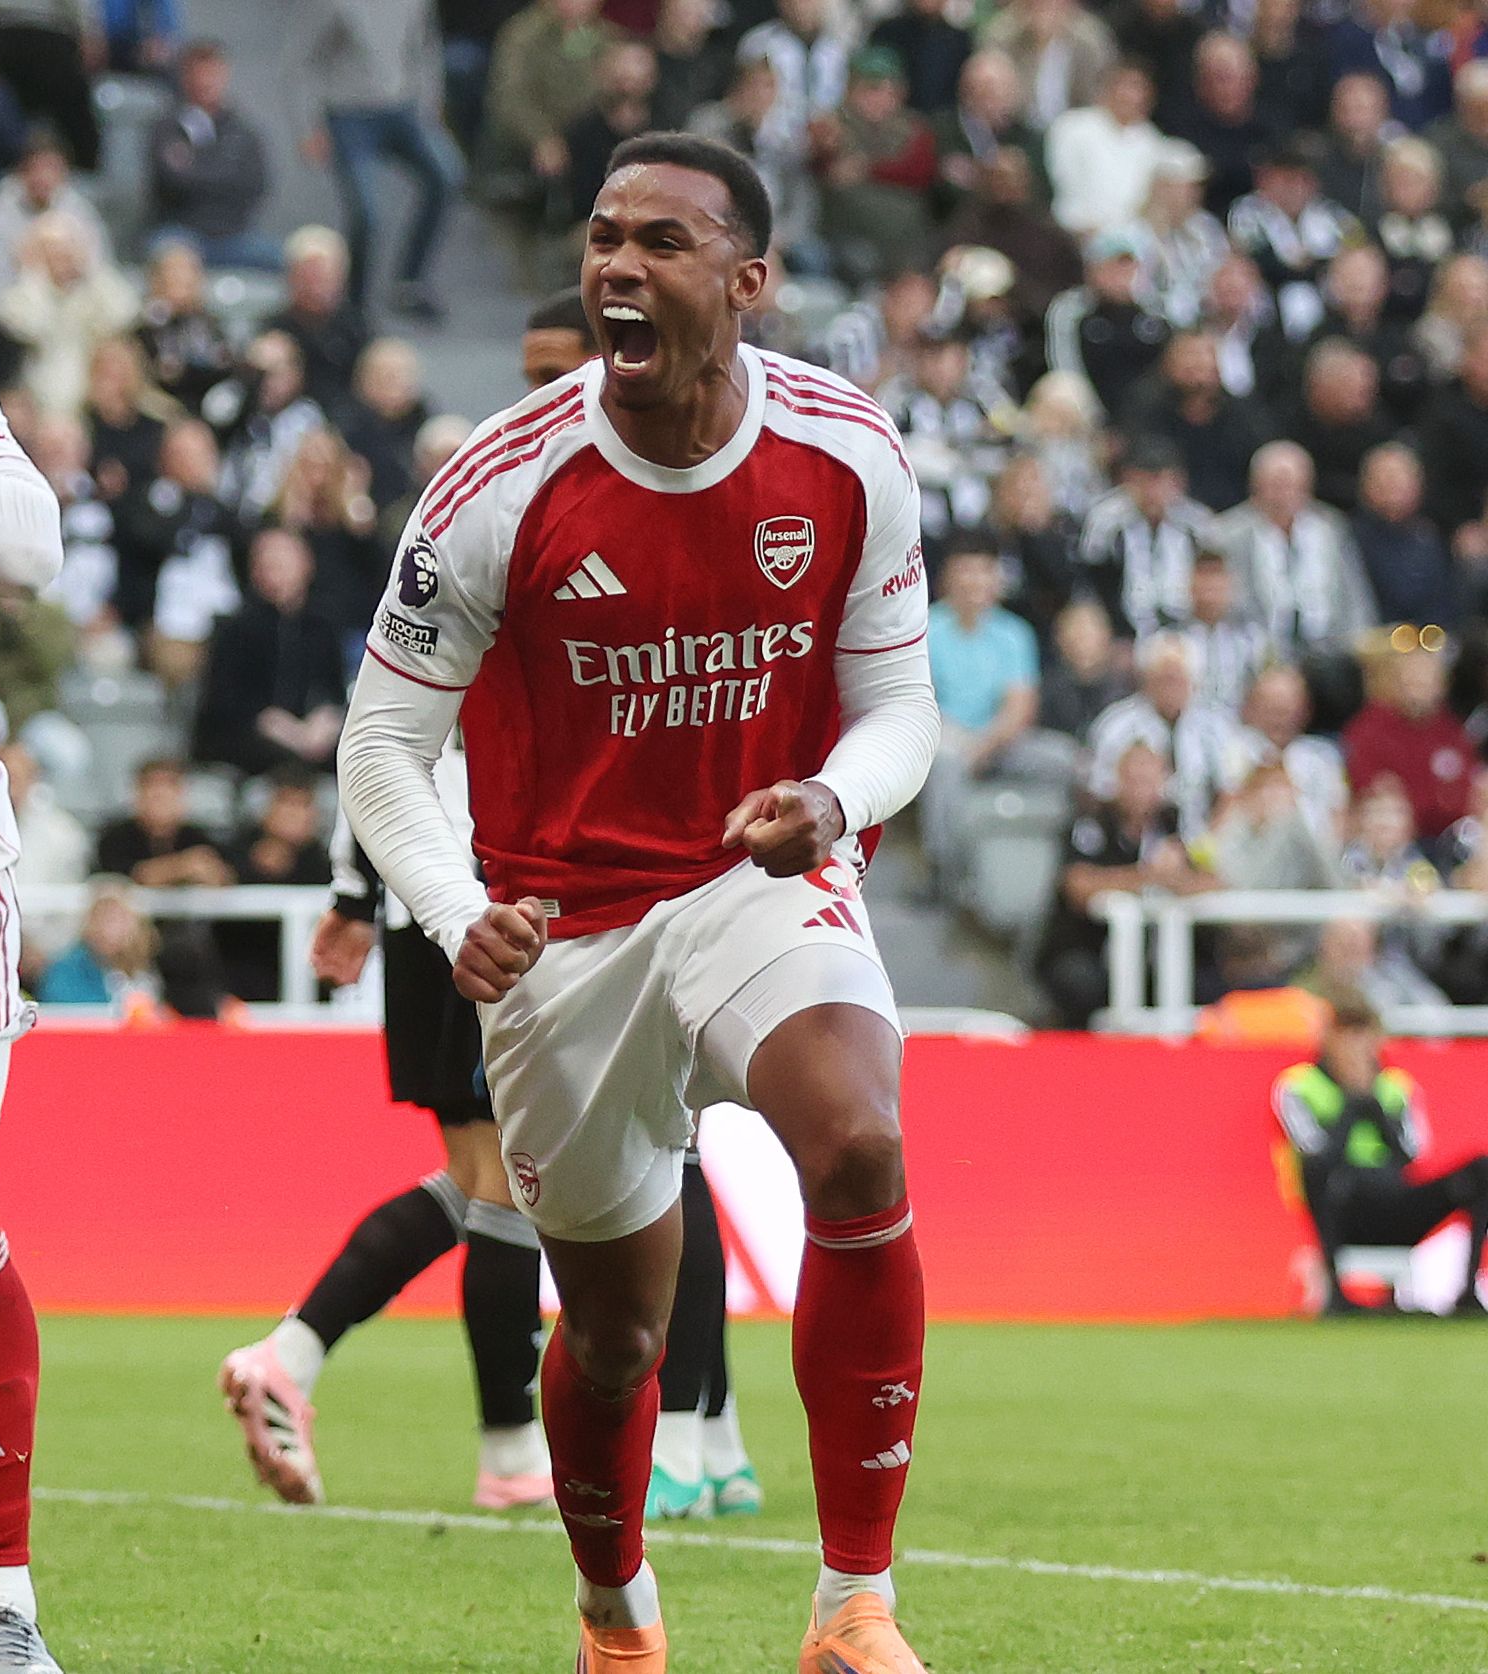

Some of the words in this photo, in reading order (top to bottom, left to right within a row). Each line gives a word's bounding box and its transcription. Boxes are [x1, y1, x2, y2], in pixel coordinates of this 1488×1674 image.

[763, 528, 807, 542] Arsenal
[388, 629, 436, 655] racism
[391, 618, 430, 641] room
[560, 620, 814, 687] Emirates
[610, 693, 660, 737] FLY
[665, 671, 772, 728] BETTER
